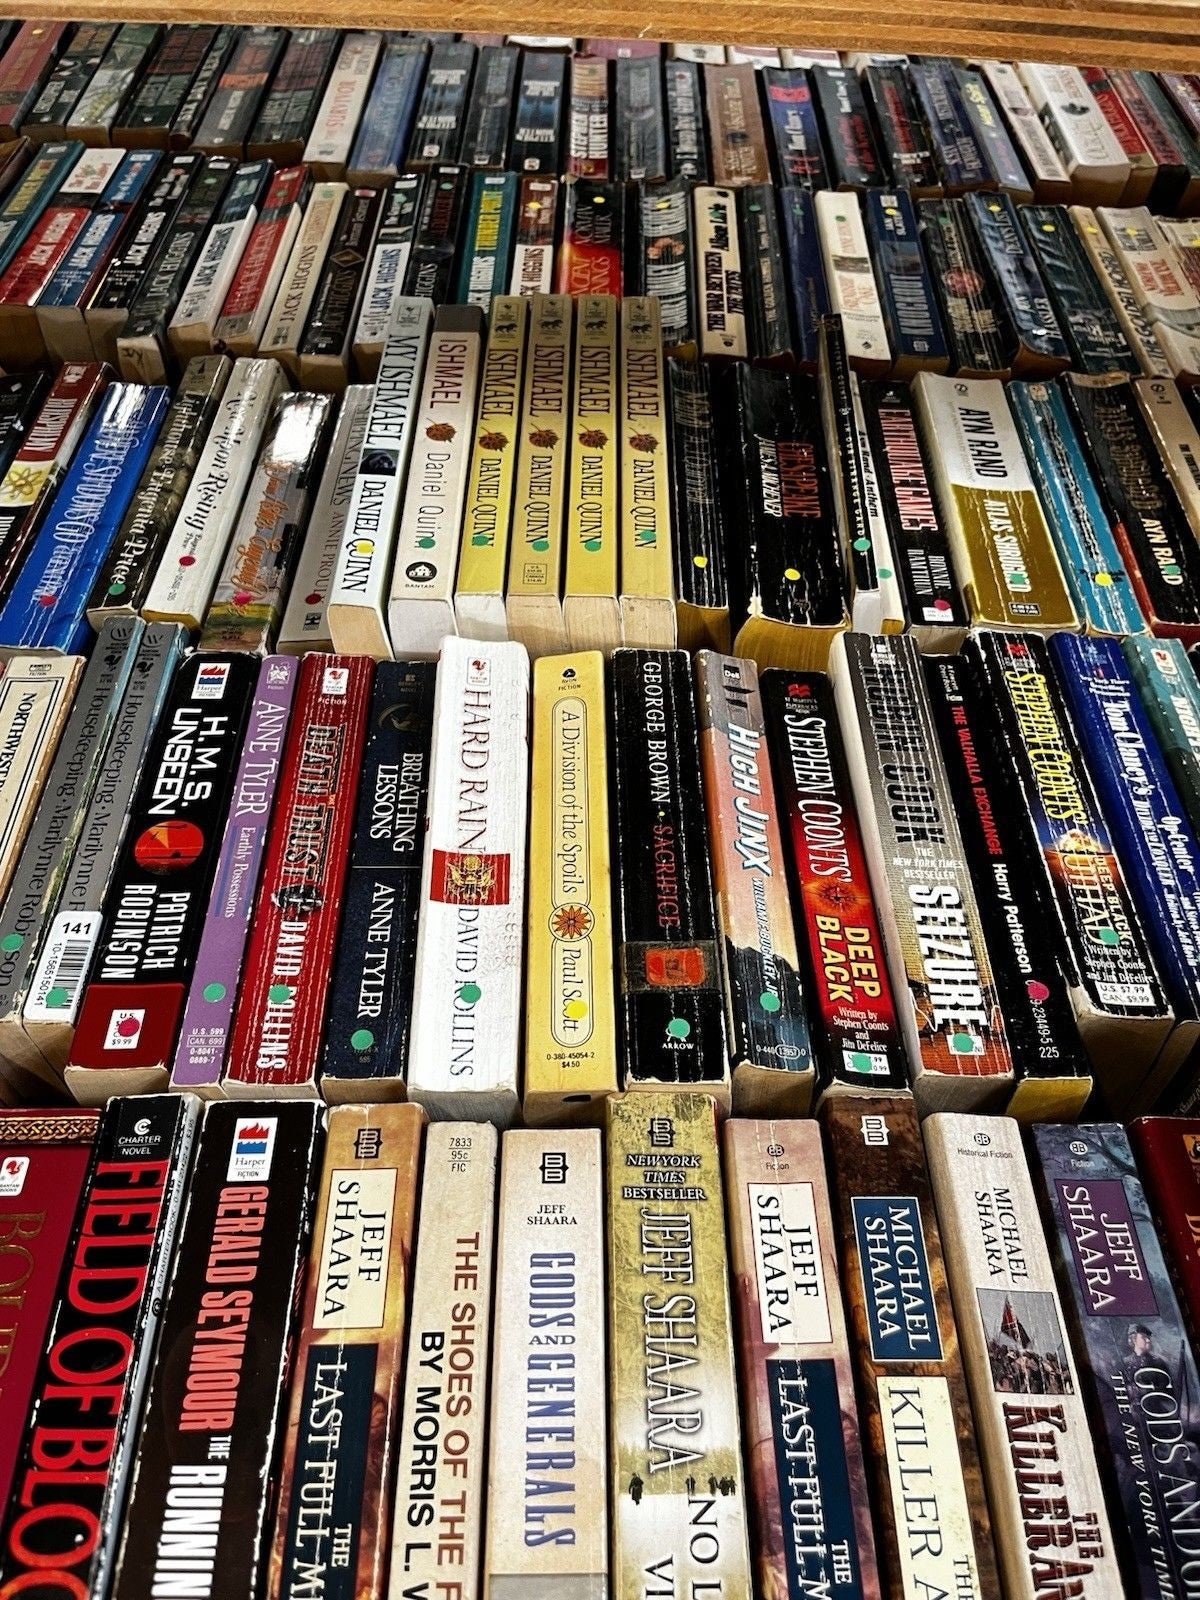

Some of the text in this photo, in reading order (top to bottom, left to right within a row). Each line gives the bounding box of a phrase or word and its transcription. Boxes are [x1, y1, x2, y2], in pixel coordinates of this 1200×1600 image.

[280, 244, 318, 323] JACK HIGGINS
[366, 335, 420, 446] MY ISHMAEL
[430, 339, 468, 409] ISHMAEL
[480, 348, 519, 420] ISHMAEL
[529, 344, 565, 418] ISHMAEL
[577, 345, 611, 418] ISHMAEL
[627, 348, 659, 421] ISHMAEL
[422, 453, 450, 497] Daniel
[529, 455, 553, 499] DANIEL
[581, 455, 603, 499] DANIEL
[878, 408, 938, 532] EARTHQUAKE GAMES
[958, 407, 1008, 479] AYN RAND
[185, 473, 230, 532] Rising
[353, 480, 387, 536] DANIEL
[476, 458, 502, 502] DANIEL
[633, 459, 656, 503] DANIEL
[865, 479, 879, 517] Anthem
[984, 500, 1011, 532] ATLAS
[1141, 518, 1167, 544] AYN
[56, 686, 109, 797] Housekeeping
[951, 706, 967, 726] THE
[94, 694, 144, 809] Housekeeping
[148, 707, 203, 815] UNSEEN
[235, 700, 286, 818] ANNE TYLER
[457, 687, 491, 853] HARD RAIN
[783, 714, 836, 796] STEPHEN
[957, 727, 983, 785] VALHALLA
[370, 764, 399, 840] LESSONS
[393, 752, 423, 853] BREATHING
[557, 710, 584, 894] A Division of the Spoils
[643, 661, 681, 928] GEORGE BROWN SACRIFICE
[727, 722, 773, 876] HIGH JINX
[882, 762, 946, 844] COOK
[972, 787, 1003, 856] EXCHANGE
[893, 857, 912, 867] NEW
[903, 869, 956, 880] BESTSELLER
[62, 922, 92, 935] 141
[101, 885, 157, 979] ROBINSON
[142, 892, 191, 970] PATRICK
[273, 921, 307, 976] DAVID
[356, 882, 396, 1020] ANNE TYLER
[455, 907, 479, 973] DAVID
[992, 863, 1033, 974] Harry Patterson
[562, 949, 583, 985] Paul
[815, 914, 854, 1004] BLACK
[843, 926, 882, 998] DEEP
[908, 885, 989, 1027] SEIZURE
[1120, 986, 1145, 994] $7.99
[662, 1042, 694, 1050] ARROW
[832, 1016, 889, 1031] Stephen Coonts
[842, 1038, 887, 1052] Jim DeFelice
[855, 1031, 870, 1040] and
[868, 1010, 877, 1022] by
[546, 1052, 595, 1060] 0-380-45054-2
[561, 1061, 580, 1069] $4.50
[1039, 1047, 1060, 1059] 225
[117, 1133, 162, 1147] CHARTER
[121, 1146, 152, 1156] NOVEL
[235, 1157, 265, 1168] Harper
[237, 1171, 259, 1179] FICTION
[450, 1137, 473, 1147] 7833
[451, 1151, 469, 1160] 95c
[451, 1163, 467, 1173] FIC
[627, 1155, 701, 1167] NEW YORK
[765, 1162, 790, 1170] Fiction
[957, 1148, 1013, 1159] Historical Fiction
[1071, 1159, 1095, 1168] Fiction
[536, 1204, 566, 1214] JEFF
[622, 1187, 706, 1200] BESTSELLER
[644, 1171, 686, 1183] TIMES
[322, 1180, 361, 1319] SHAARA
[358, 1209, 387, 1283] JEFF
[527, 1216, 578, 1226] SHAARA
[974, 1191, 1006, 1277] SHAARA
[992, 1186, 1029, 1284] MICHAEL
[1061, 1185, 1117, 1311] SHAARA
[1100, 1212, 1143, 1283] JEFF
[43, 1160, 166, 1416] FIELD OF
[528, 1252, 576, 1328] GODS
[757, 1194, 793, 1333] SHAARA
[782, 1223, 819, 1298] JEFF
[863, 1216, 901, 1338] SHAARA
[889, 1206, 931, 1350] MICHAEL
[179, 1186, 269, 1431] GERALD SEYMOUR
[528, 1335, 577, 1345] AND
[640, 1208, 704, 1474] JEFF SHAARA
[437, 1232, 480, 1566] THE SHOES OF THE
[1134, 1366, 1191, 1464] GODS
[208, 1435, 232, 1460] THE
[295, 1362, 348, 1548] LAST FULL
[404, 1332, 445, 1572] BY MORRIS L.
[524, 1353, 576, 1547] GENERALS
[777, 1377, 827, 1565] LAST FULL
[888, 1386, 944, 1560] KILLER
[1002, 1402, 1074, 1552] KILLER
[1111, 1370, 1161, 1540] THE NEW YORK
[331, 1523, 353, 1568] THE
[687, 1496, 720, 1564] NO
[831, 1540, 852, 1584] THE
[1072, 1512, 1104, 1559] THE
